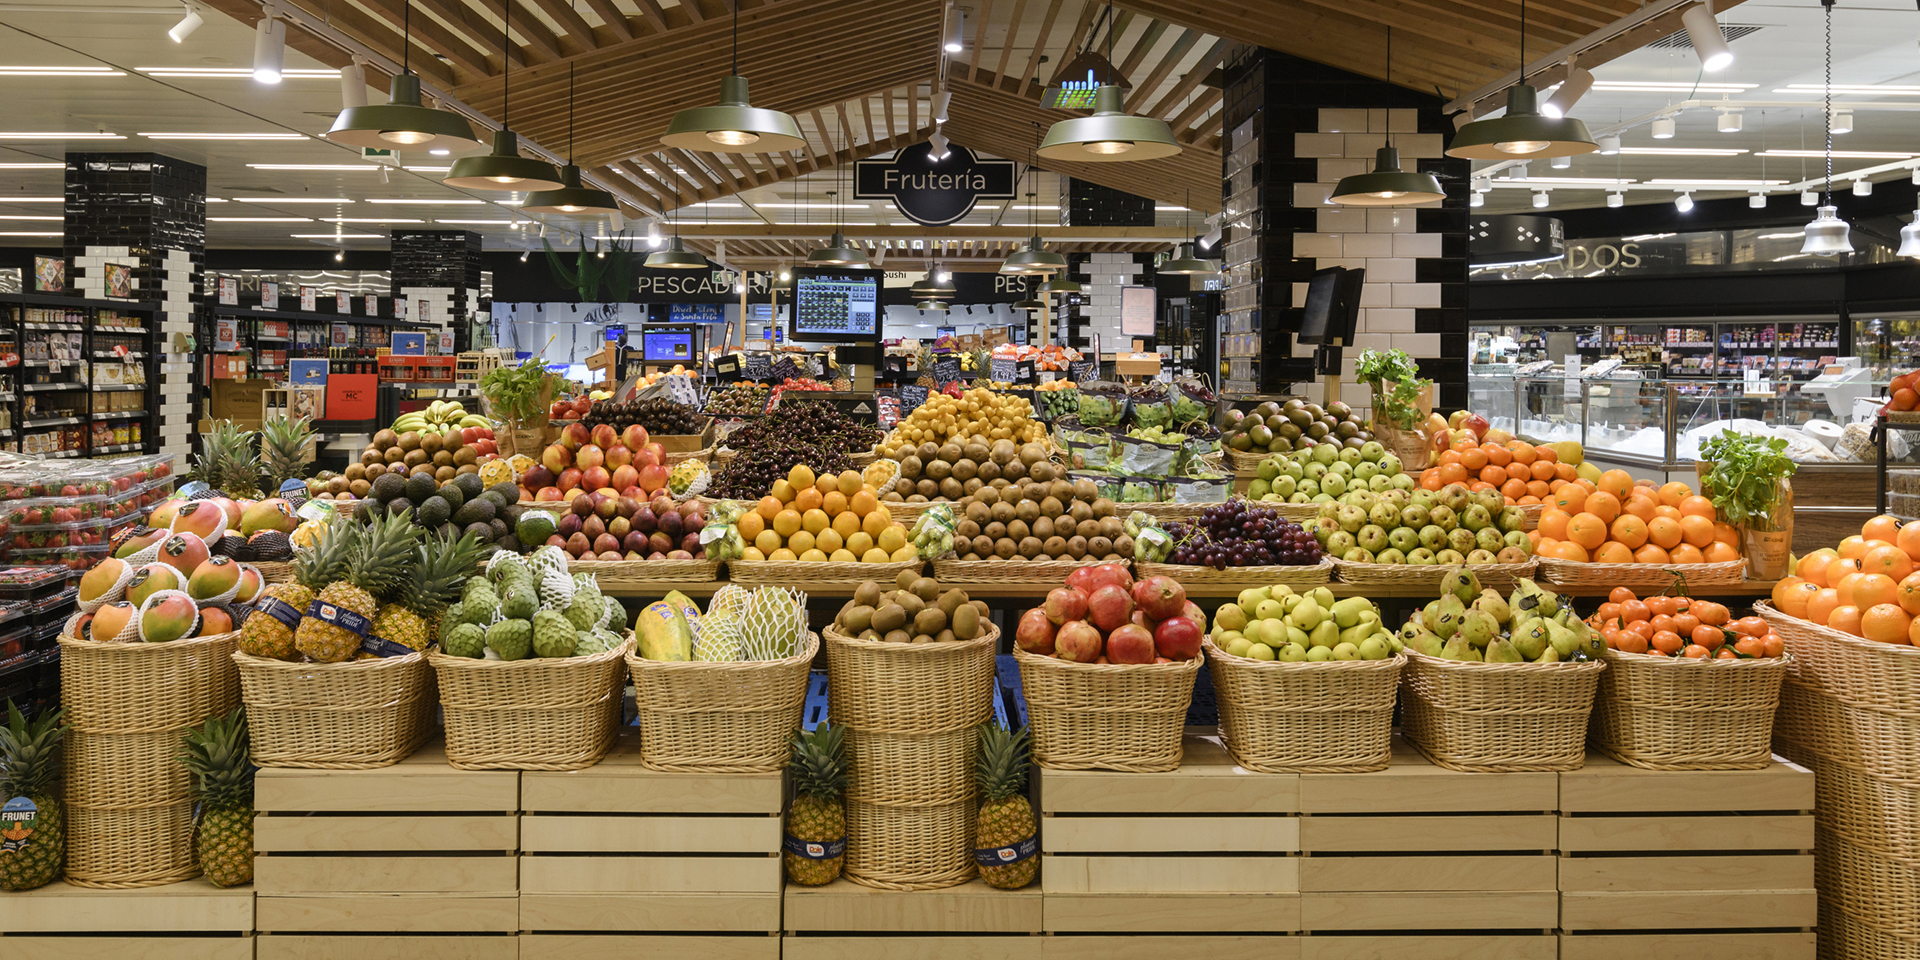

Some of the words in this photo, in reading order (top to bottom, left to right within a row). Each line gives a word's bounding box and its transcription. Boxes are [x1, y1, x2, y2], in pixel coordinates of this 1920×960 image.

[884, 168, 986, 190] Frutería
[346, 392, 358, 400] MC
[322, 607, 336, 616] Dole
[1, 811, 36, 821] FRUNET
[809, 845, 823, 854] Dole
[1000, 849, 1015, 859] Dole
